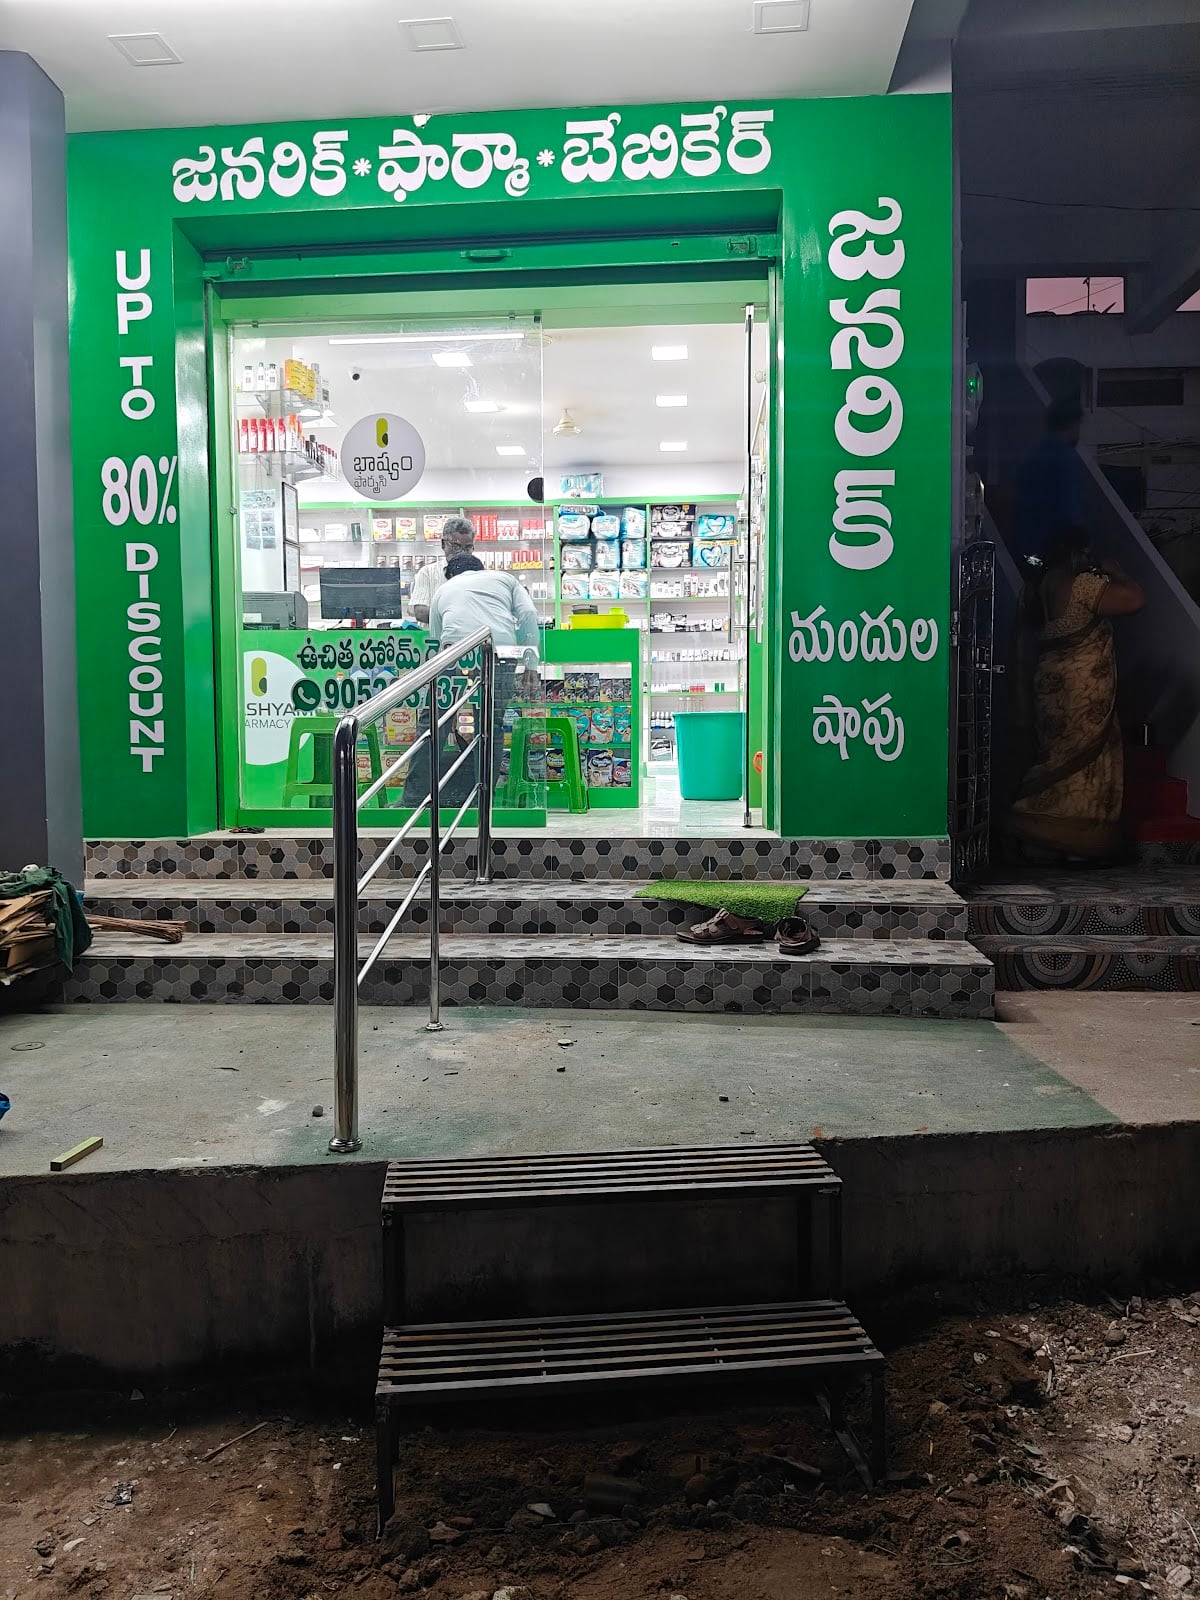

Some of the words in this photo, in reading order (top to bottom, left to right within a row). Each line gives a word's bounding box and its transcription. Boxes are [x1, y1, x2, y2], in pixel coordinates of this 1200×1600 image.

[172, 130, 349, 203] జనరిక్
[378, 129, 531, 203] ఫార్మా
[561, 105, 774, 183] బేబికేర్
[115, 248, 153, 335] UP
[119, 356, 155, 420] TO
[828, 196, 905, 571] జనరిక్
[101, 454, 178, 526] 80%
[353, 451, 413, 481] భాష్యం
[125, 542, 165, 773] DISCOUNT
[297, 637, 354, 670] ఉచిత
[359, 635, 421, 670] హోమ్
[788, 604, 939, 662] మందుల
[812, 692, 905, 762] షాపు
